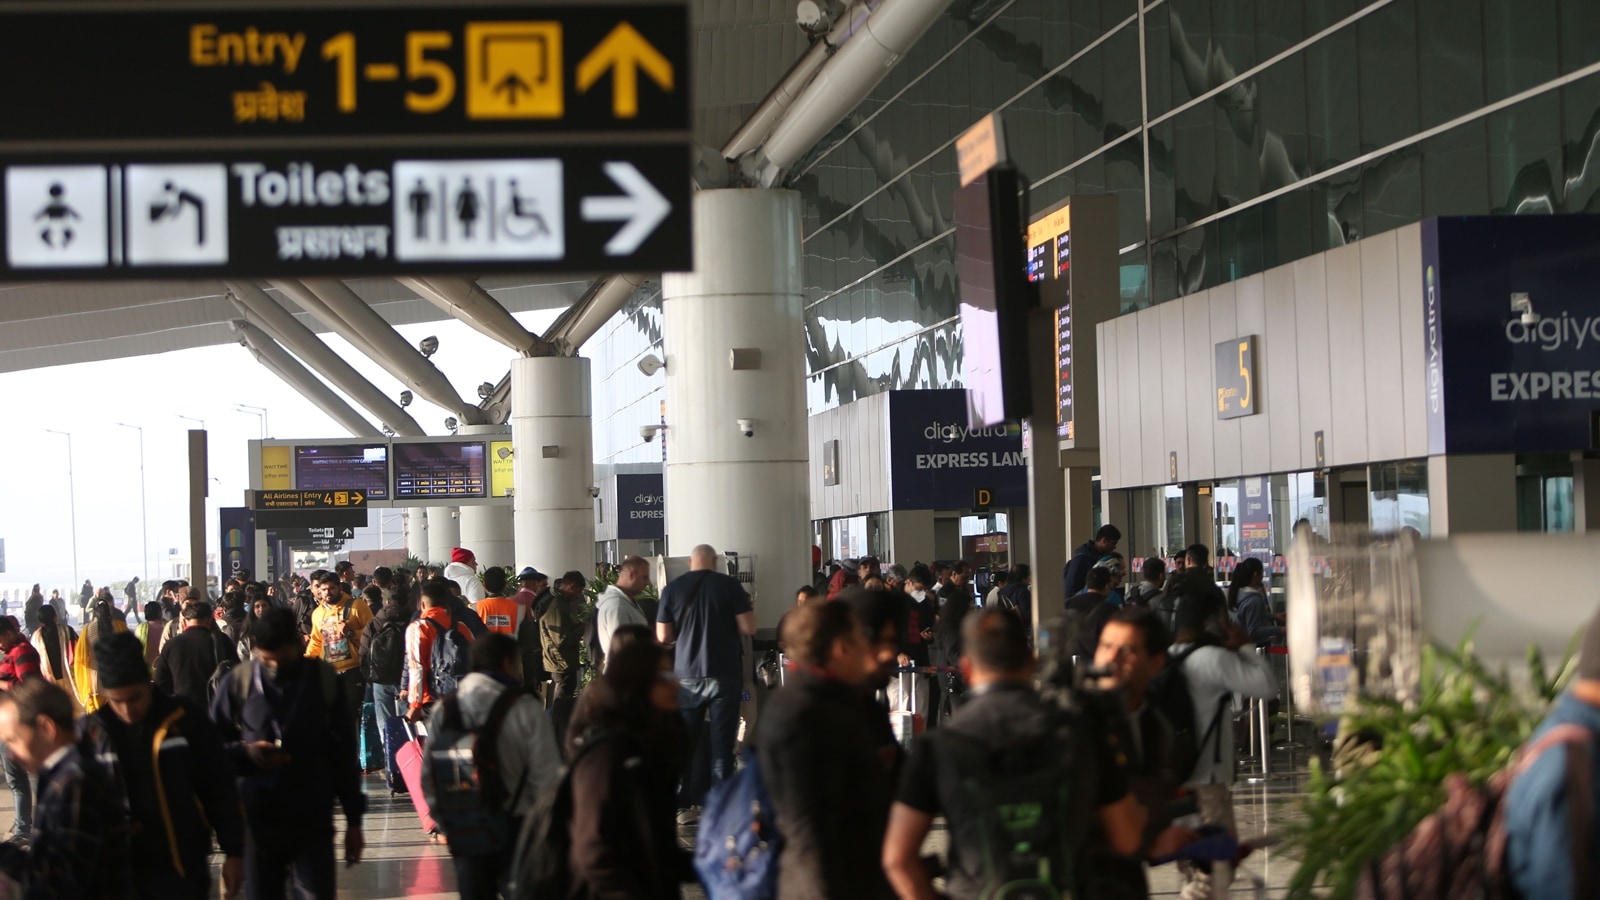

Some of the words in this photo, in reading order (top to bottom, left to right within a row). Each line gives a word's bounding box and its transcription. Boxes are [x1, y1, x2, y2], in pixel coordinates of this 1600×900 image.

[190, 24, 306, 74] Entry
[321, 31, 456, 113] 1-5
[233, 81, 307, 122] प्रवेश
[231, 161, 391, 206] Toilets
[1239, 342, 1250, 408] 5
[916, 453, 989, 469] EXPRESS
[1316, 436, 1323, 463] C
[304, 492, 321, 500] Entry
[324, 492, 332, 504] 4
[978, 490, 991, 505] D
[630, 510, 664, 518] EXPRES
